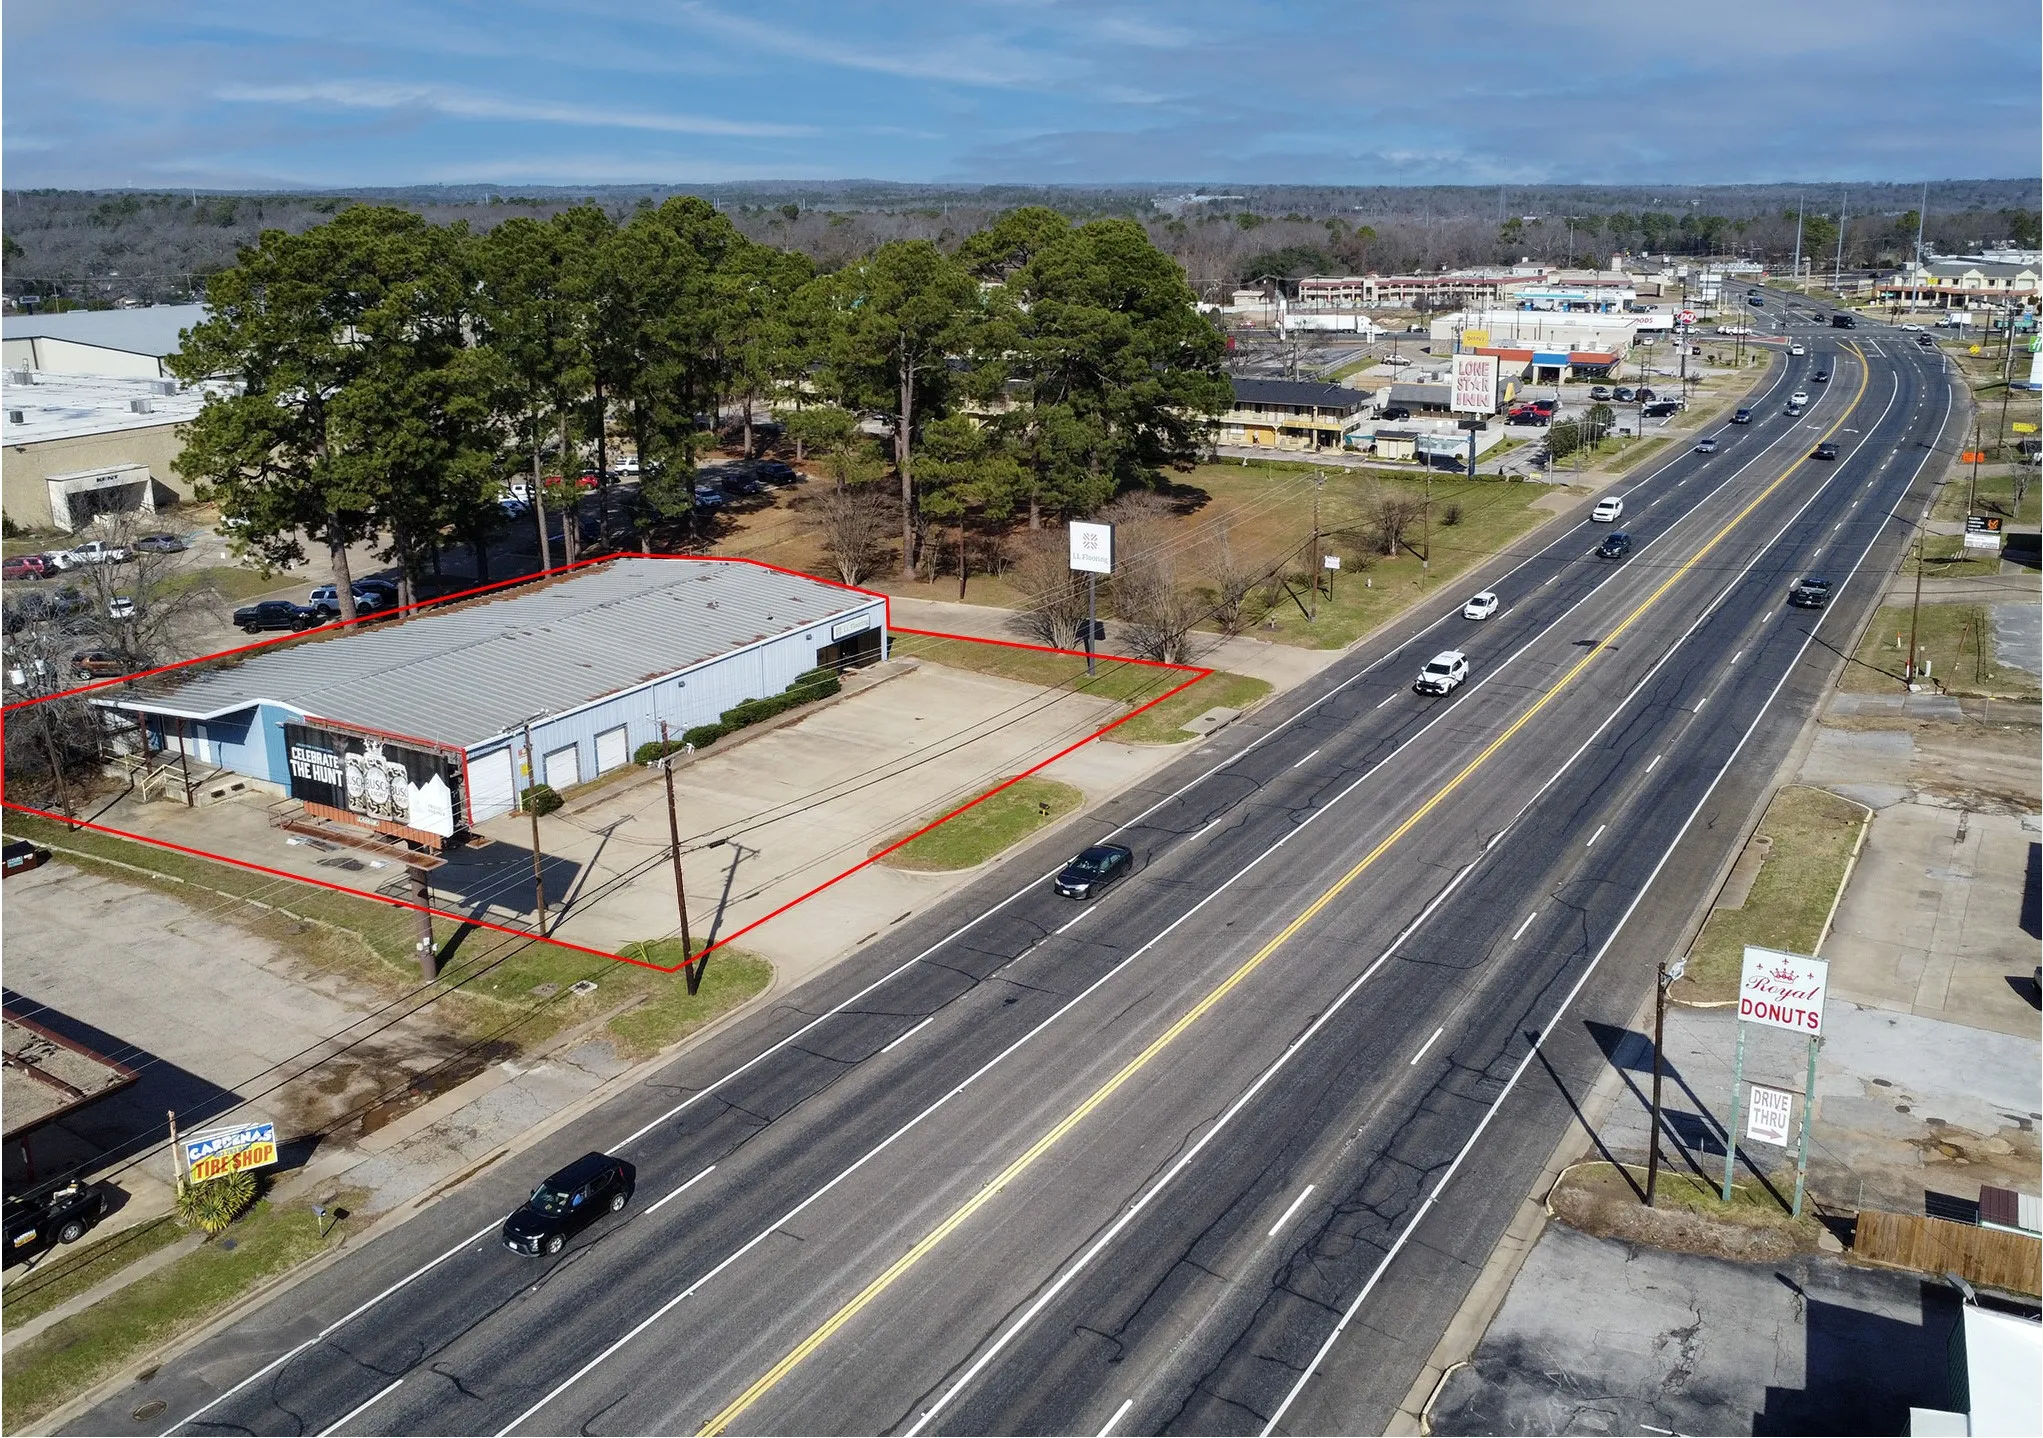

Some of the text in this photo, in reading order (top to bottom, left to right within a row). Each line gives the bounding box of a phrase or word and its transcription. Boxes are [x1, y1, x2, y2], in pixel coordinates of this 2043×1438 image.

[1680, 312, 1695, 321] DQ
[1458, 360, 1490, 377] LONE
[1456, 393, 1490, 407] INN
[1082, 554, 1109, 565] Flooring
[291, 746, 339, 769] CELEBRATE
[289, 759, 343, 787] THE HUNT
[1746, 975, 1820, 1002] Royal
[1741, 998, 1819, 1030] DONUTS
[1753, 1089, 1789, 1112] DRIVE
[1753, 1107, 1787, 1130] THRU
[190, 1129, 272, 1160] CARDENAS
[232, 1145, 273, 1170] SHOP
